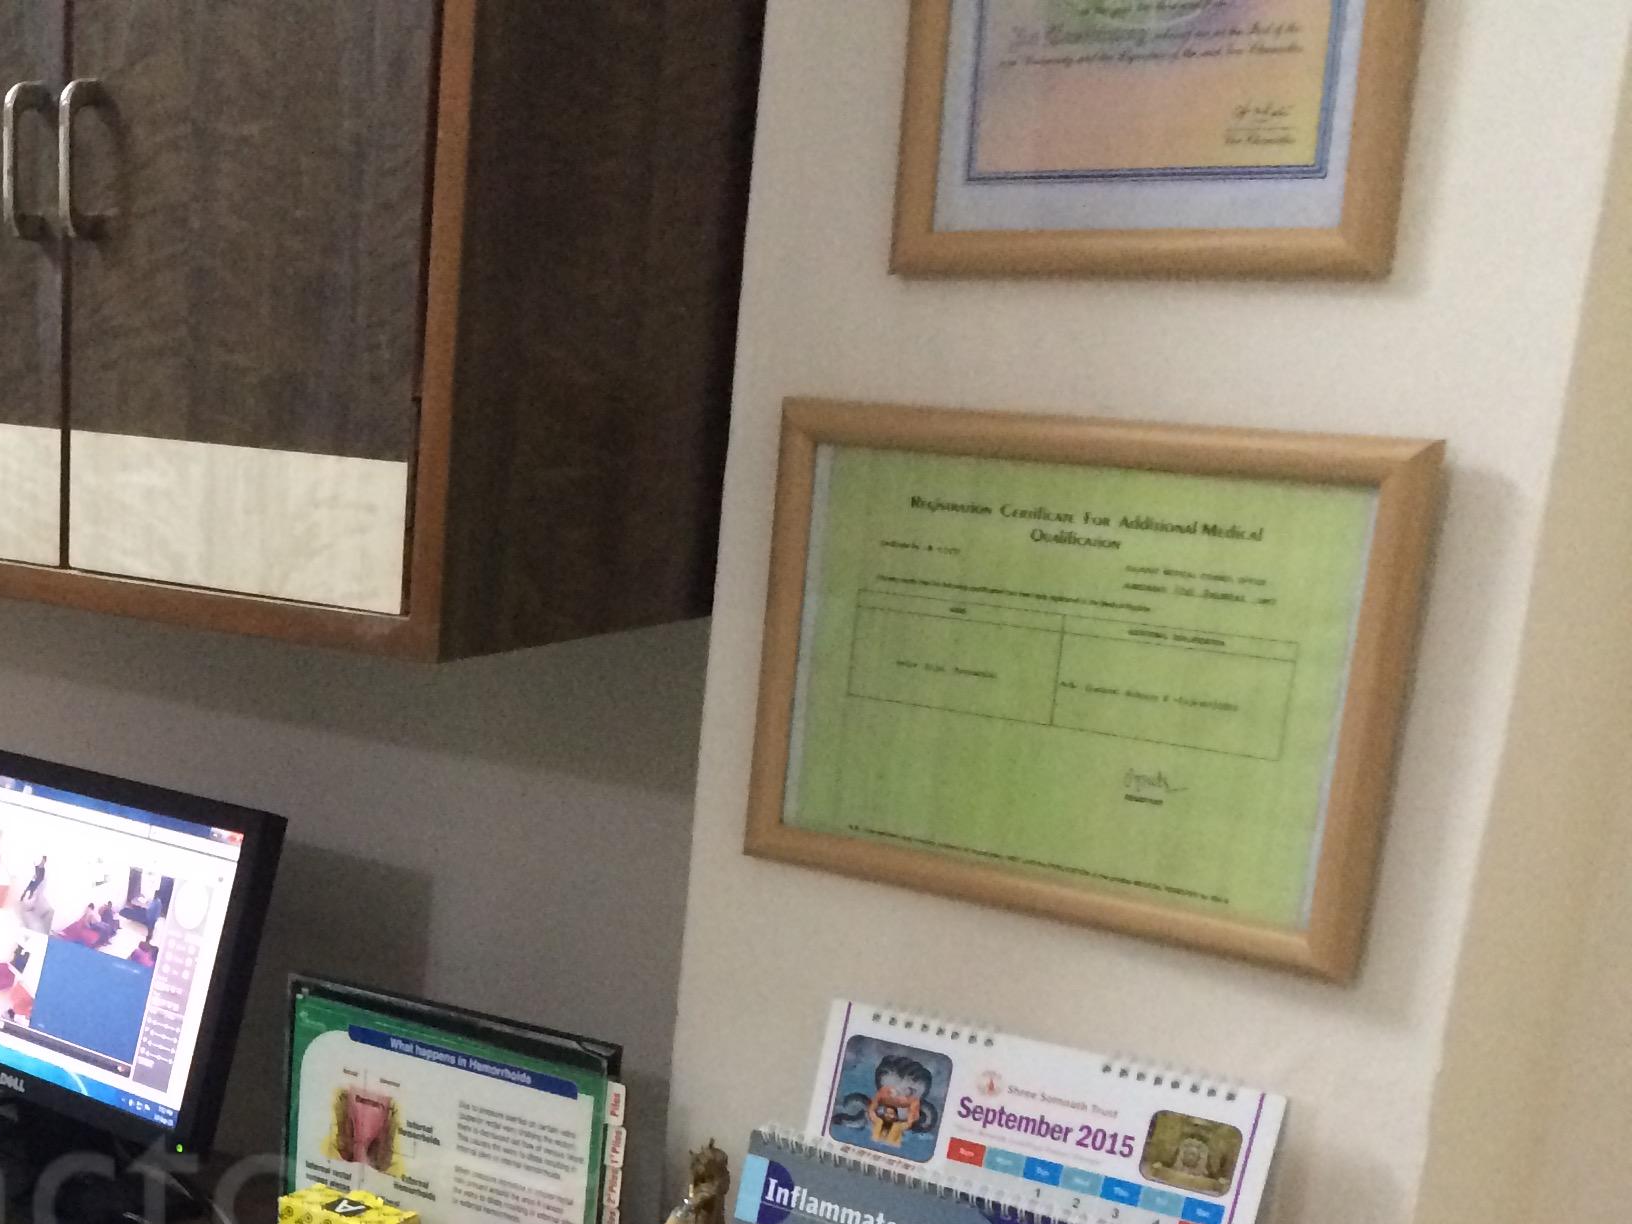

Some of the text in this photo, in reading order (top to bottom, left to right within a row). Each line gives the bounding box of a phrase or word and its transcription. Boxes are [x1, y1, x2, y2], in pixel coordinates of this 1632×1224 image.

[1202, 523, 1263, 542] Medical
[0, 1072, 25, 1093] DELL
[957, 1096, 1074, 1143] September
[1075, 1124, 1136, 1159] 2015
[1071, 1197, 1081, 1208] 2
[1111, 1208, 1120, 1219] 3
